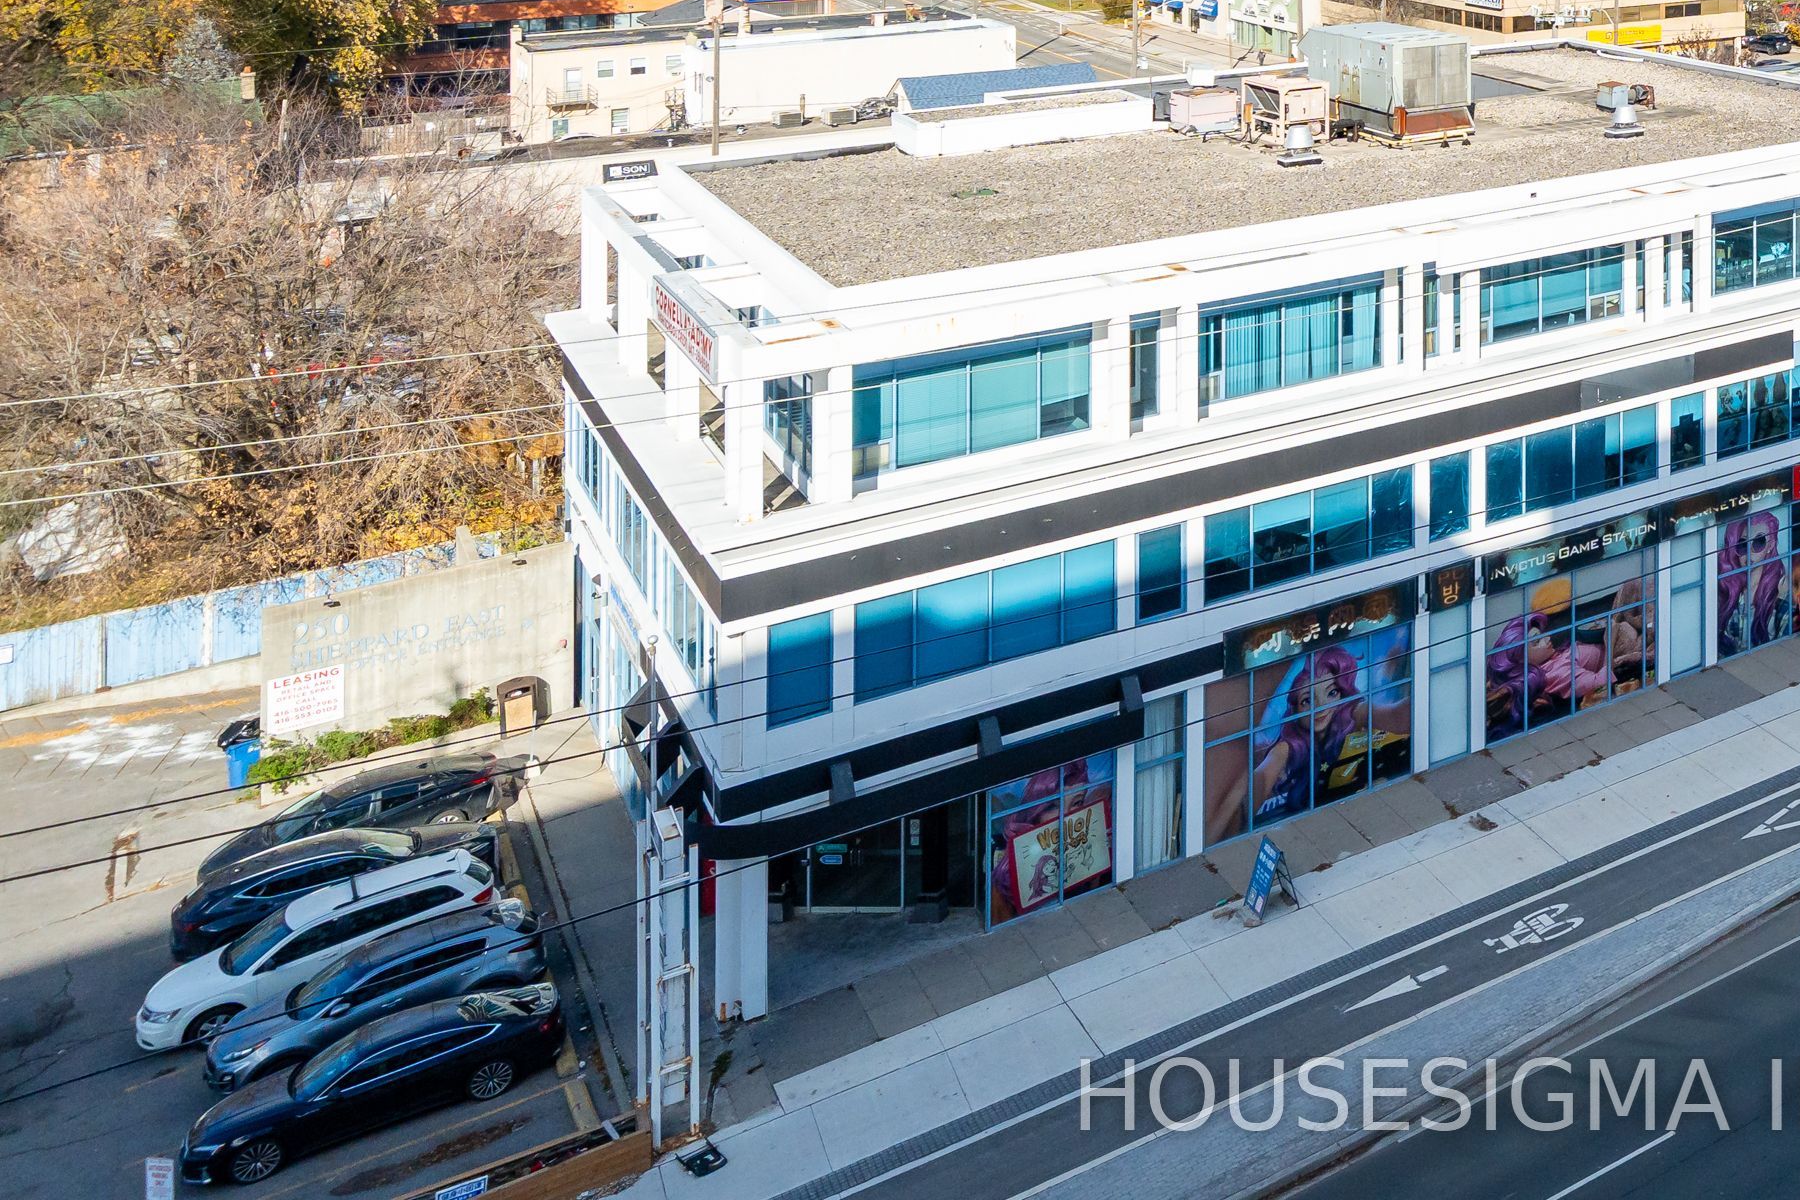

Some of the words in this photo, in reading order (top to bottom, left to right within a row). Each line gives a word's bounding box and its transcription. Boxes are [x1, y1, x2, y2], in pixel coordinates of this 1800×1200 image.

[1558, 539, 1600, 560] GAME
[1601, 521, 1657, 546] STATION
[1442, 582, 1461, 605] 방
[289, 623, 430, 669] SHEPPARD
[446, 604, 506, 632] EAST
[292, 612, 351, 646] 250
[273, 667, 340, 689] LEASING
